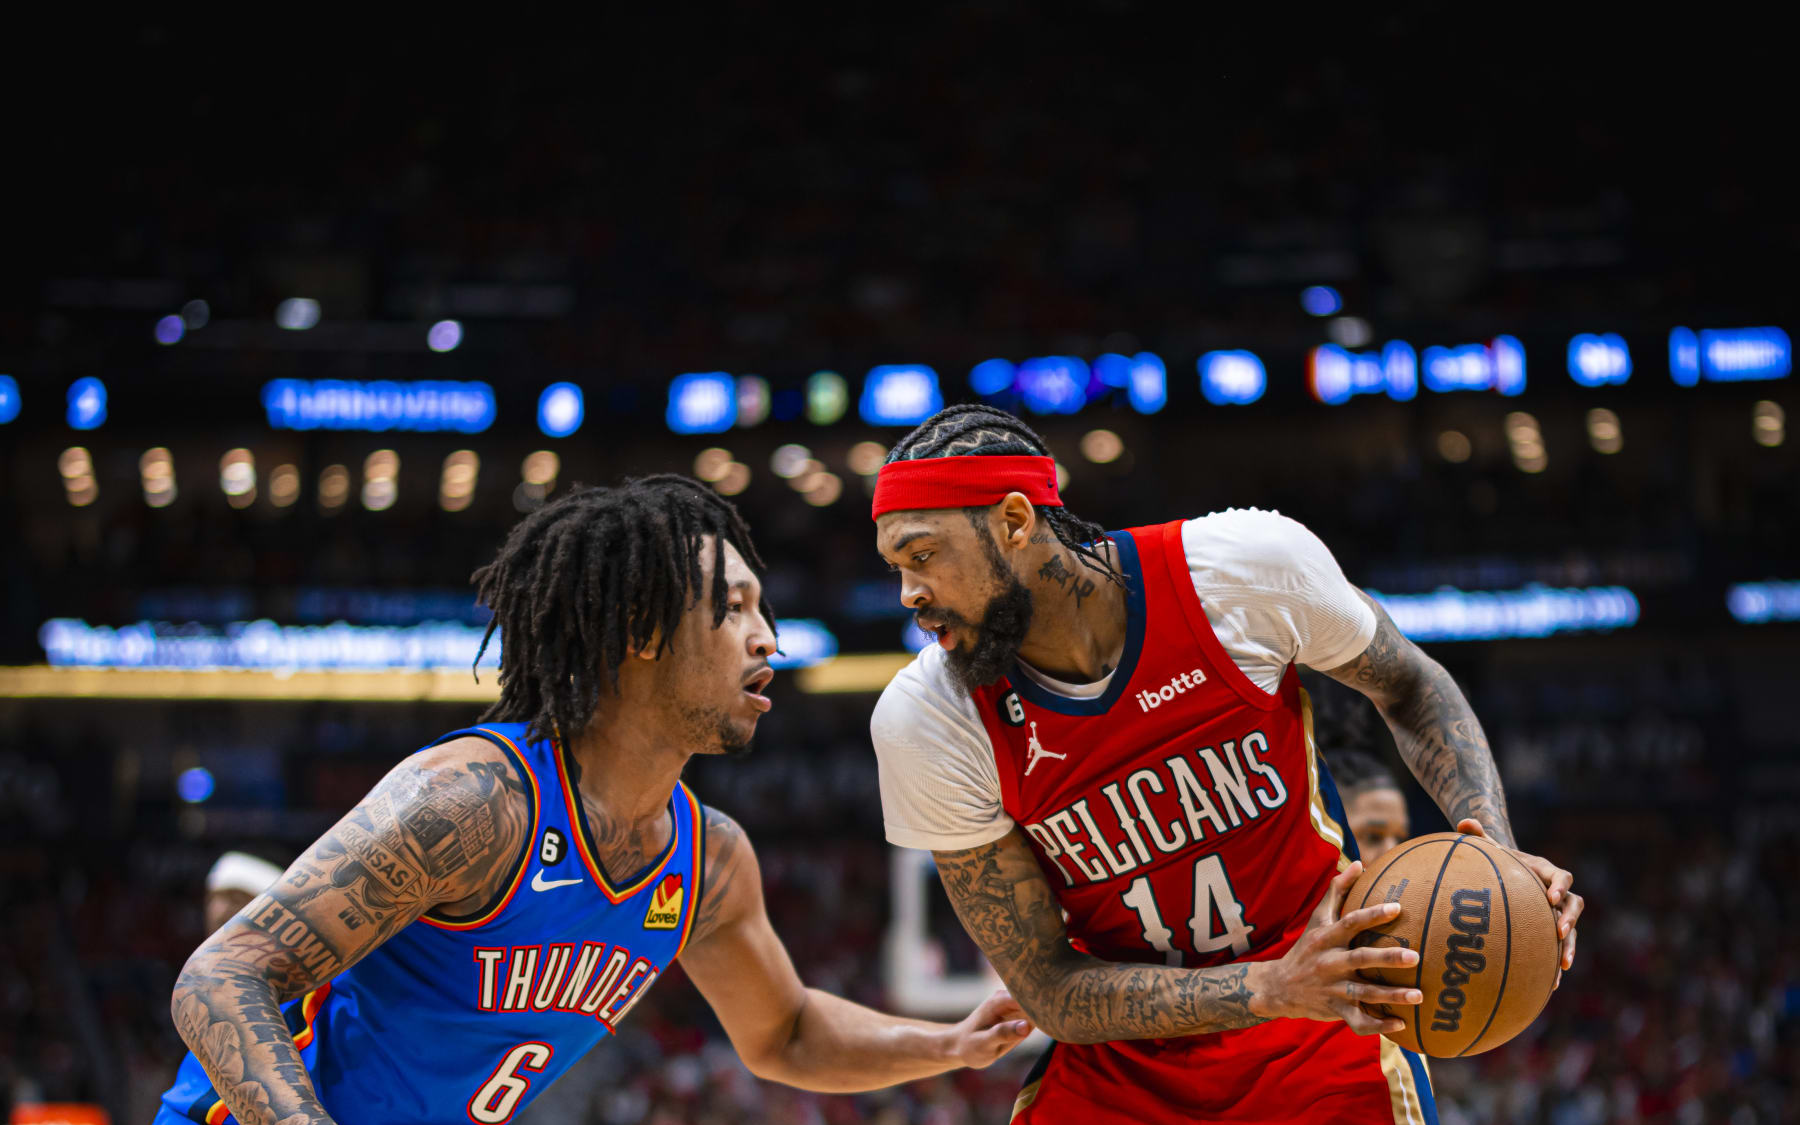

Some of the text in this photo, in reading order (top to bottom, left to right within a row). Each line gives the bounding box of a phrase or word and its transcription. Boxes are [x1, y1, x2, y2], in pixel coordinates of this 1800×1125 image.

[1004, 691, 1026, 724] 6
[1135, 667, 1207, 713] ibotta
[541, 831, 560, 864] 6
[1024, 730, 1288, 888] PELICANS
[1121, 852, 1256, 968] 14
[1430, 888, 1493, 1033] Wilson
